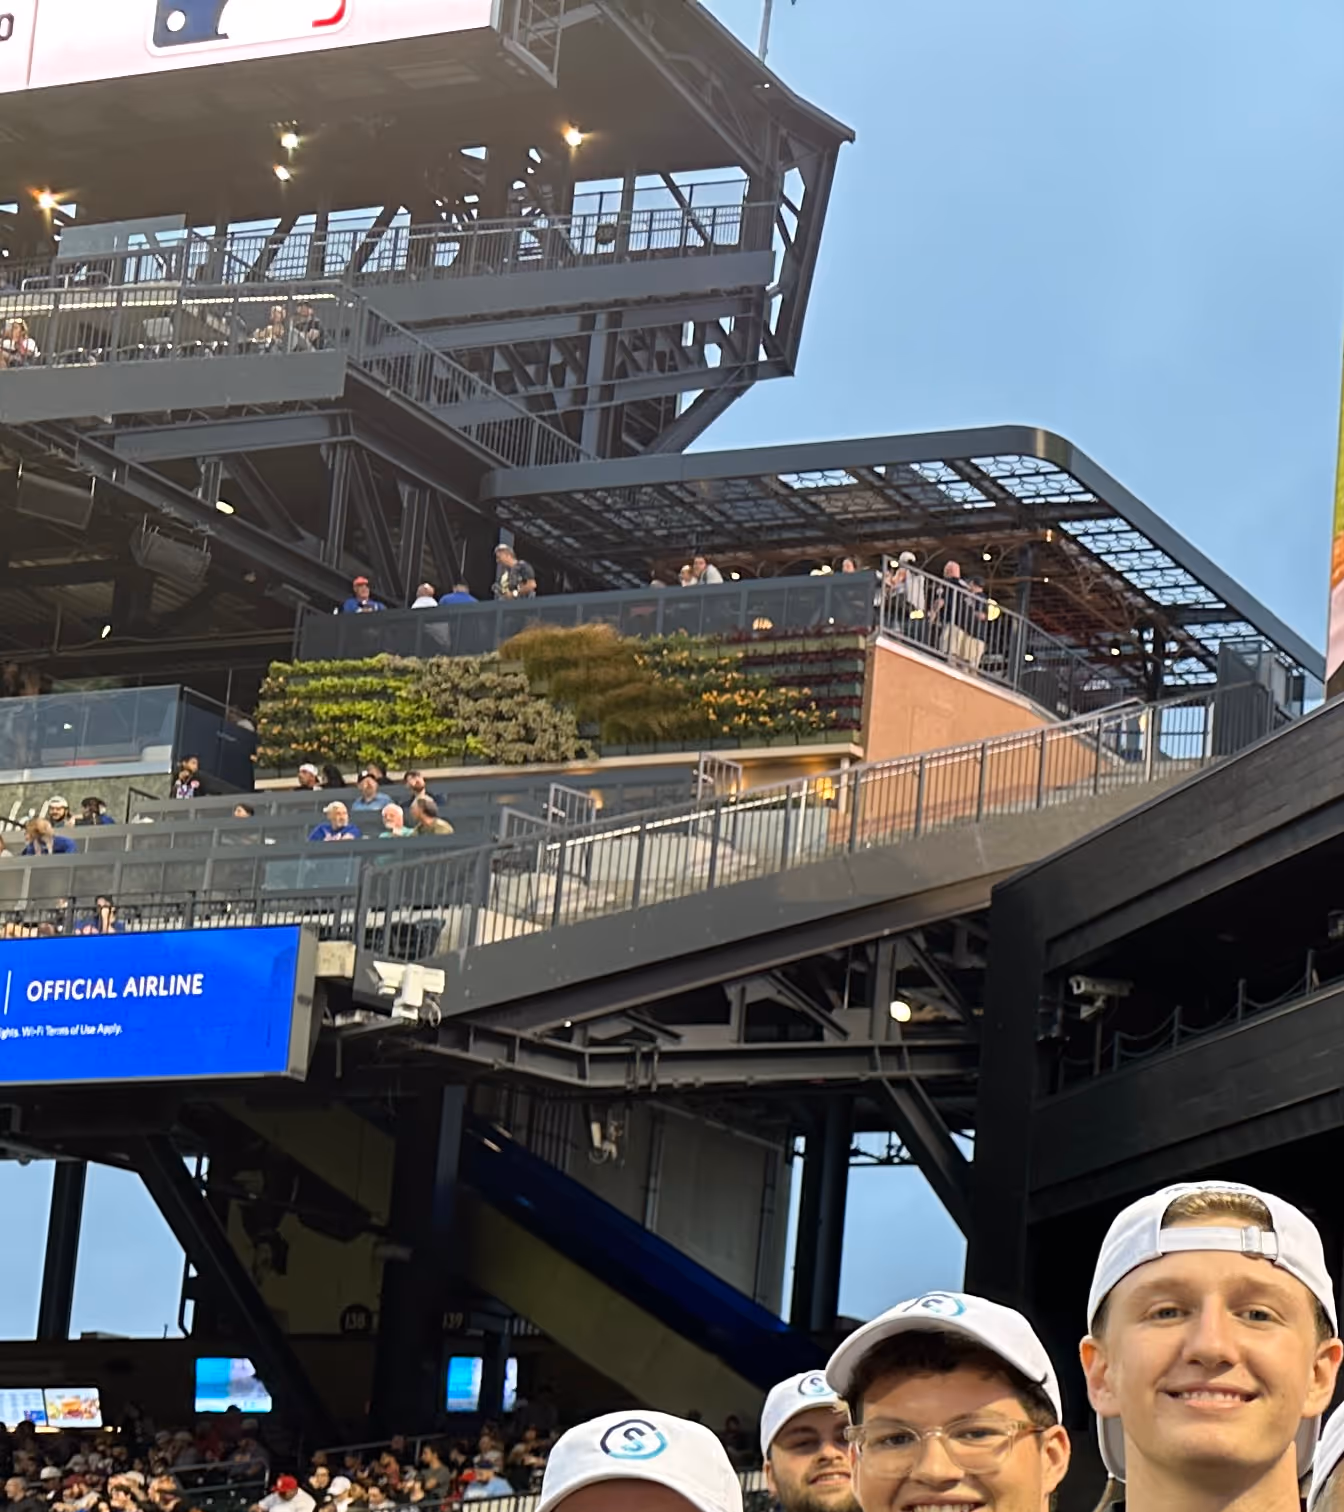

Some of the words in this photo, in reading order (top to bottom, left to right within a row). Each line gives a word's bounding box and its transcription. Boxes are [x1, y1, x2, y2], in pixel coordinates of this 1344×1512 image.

[26, 976, 118, 1002] OFFICIAL
[122, 973, 204, 998] AIRLINE
[70, 1023, 80, 1036] of
[80, 1023, 96, 1036] Use
